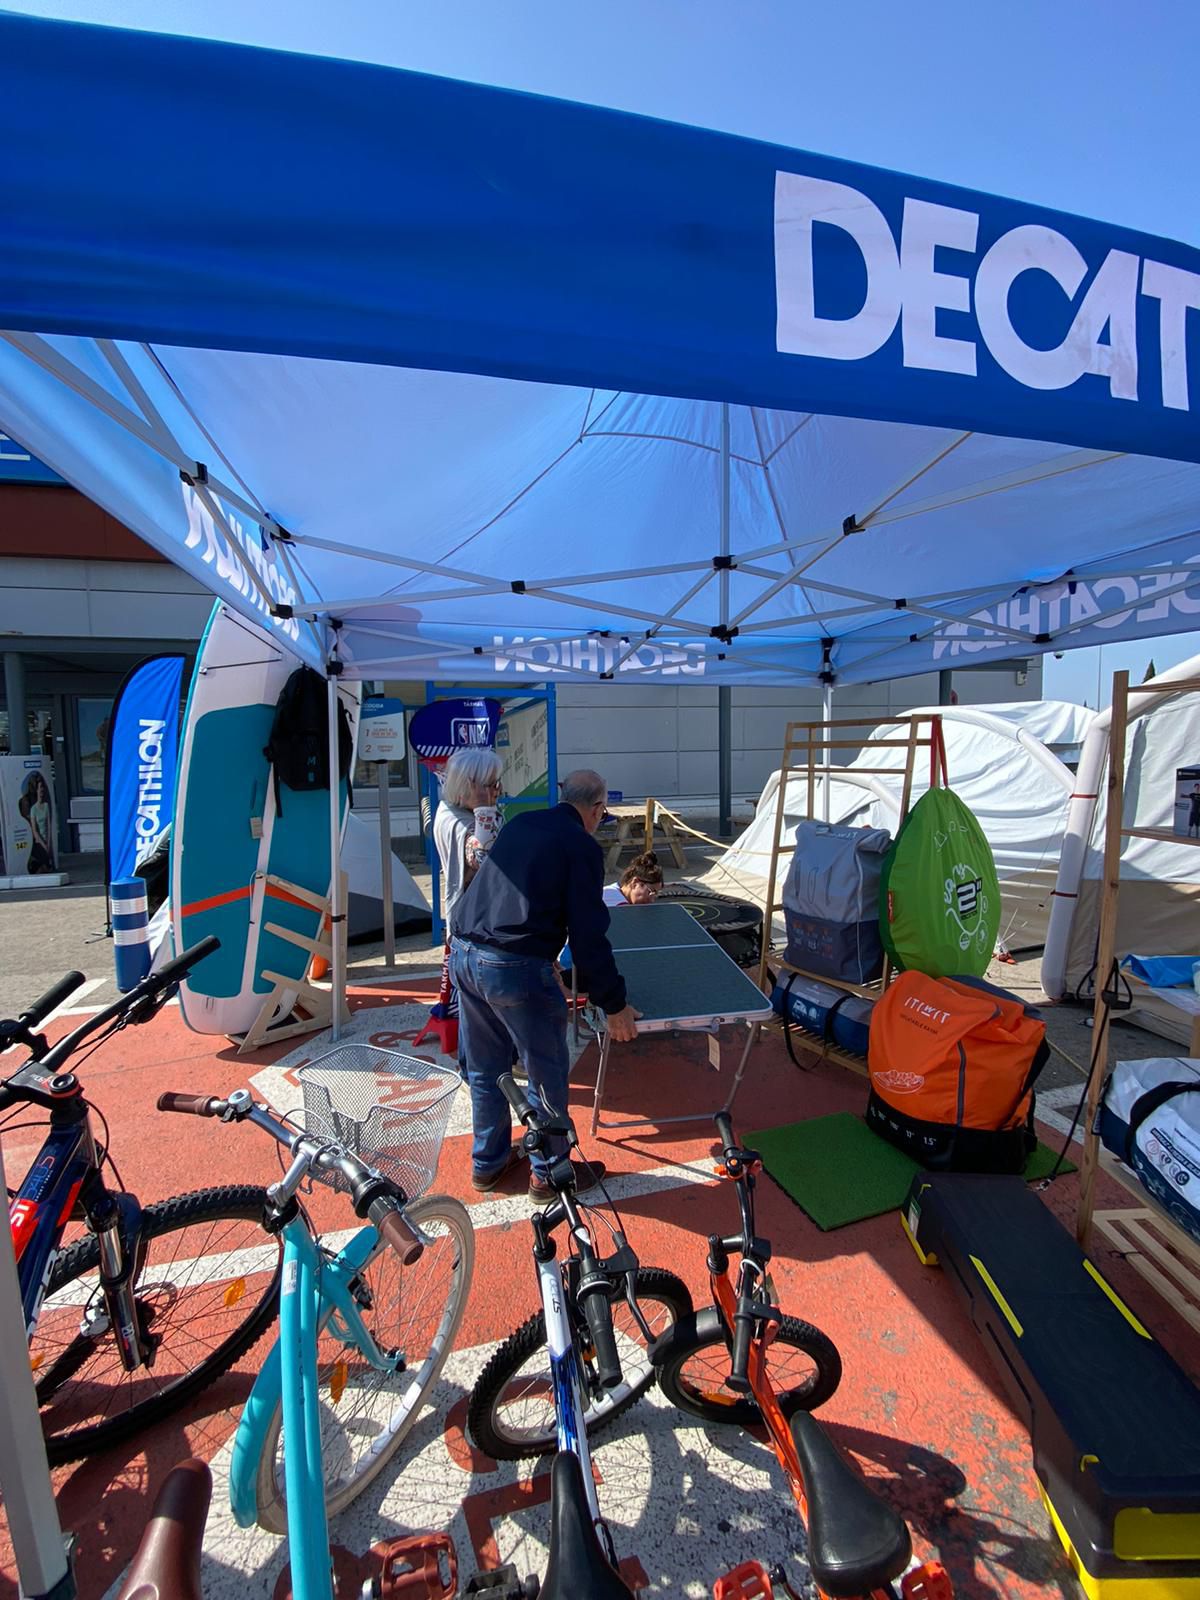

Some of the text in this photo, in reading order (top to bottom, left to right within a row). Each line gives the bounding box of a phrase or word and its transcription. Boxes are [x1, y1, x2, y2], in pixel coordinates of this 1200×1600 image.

[774, 170, 1200, 412] DECAT
[132, 719, 166, 877] ECATHLON
[469, 723, 487, 745] NBA
